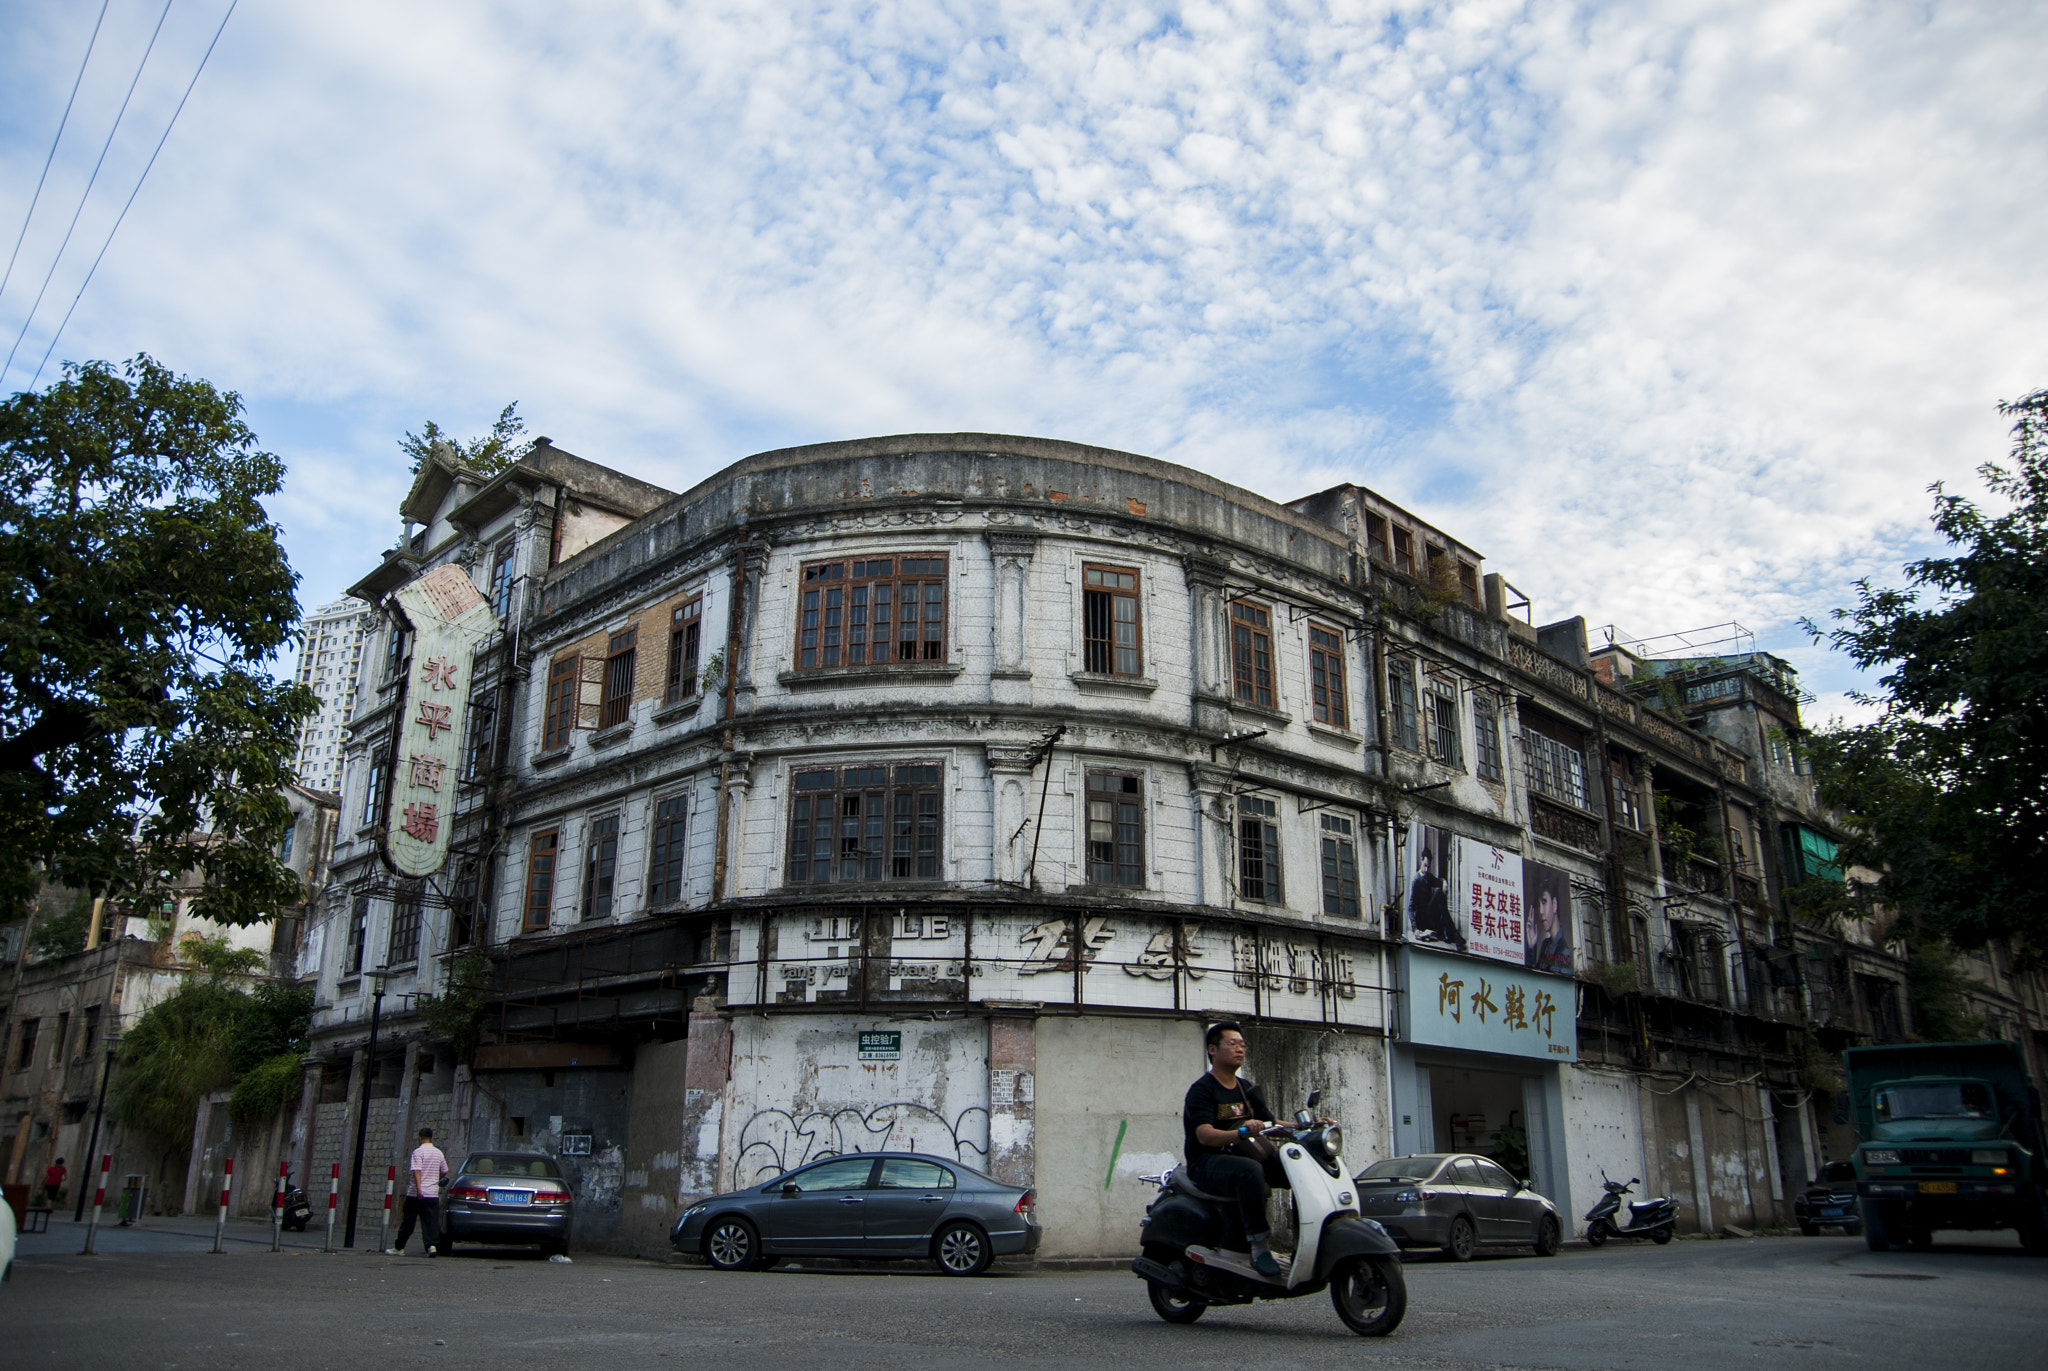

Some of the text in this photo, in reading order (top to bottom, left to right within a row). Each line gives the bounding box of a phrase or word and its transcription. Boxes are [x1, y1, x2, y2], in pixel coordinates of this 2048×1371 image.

[402, 656, 457, 844] 永平商場
[1471, 882, 1522, 917] 男女皮鞋
[892, 915, 949, 940] LE
[1470, 909, 1522, 943] 粤东代理
[781, 961, 983, 985] tang yan shang din
[1438, 971, 1556, 1039] 阿水鞋行
[861, 1034, 899, 1045] 虫控验厂
